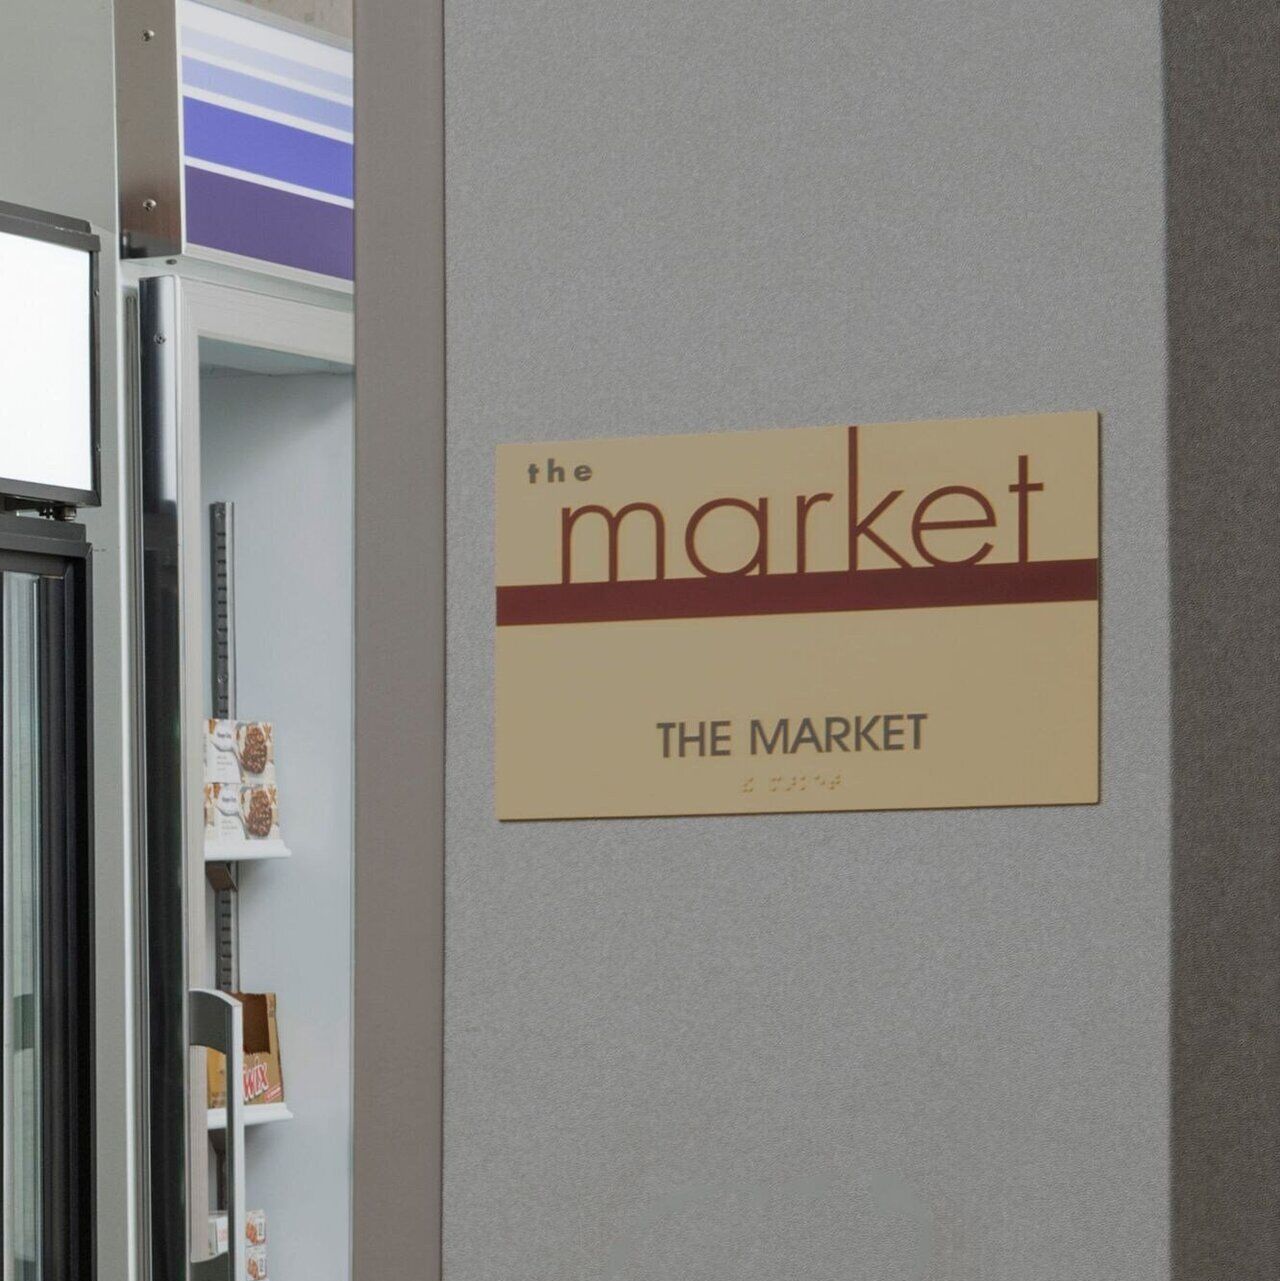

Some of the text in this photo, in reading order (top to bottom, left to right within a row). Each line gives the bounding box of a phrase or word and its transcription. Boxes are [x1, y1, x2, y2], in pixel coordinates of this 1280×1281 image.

[527, 459, 593, 485] the
[561, 426, 1044, 585] market
[656, 713, 929, 759] THE MARKET
